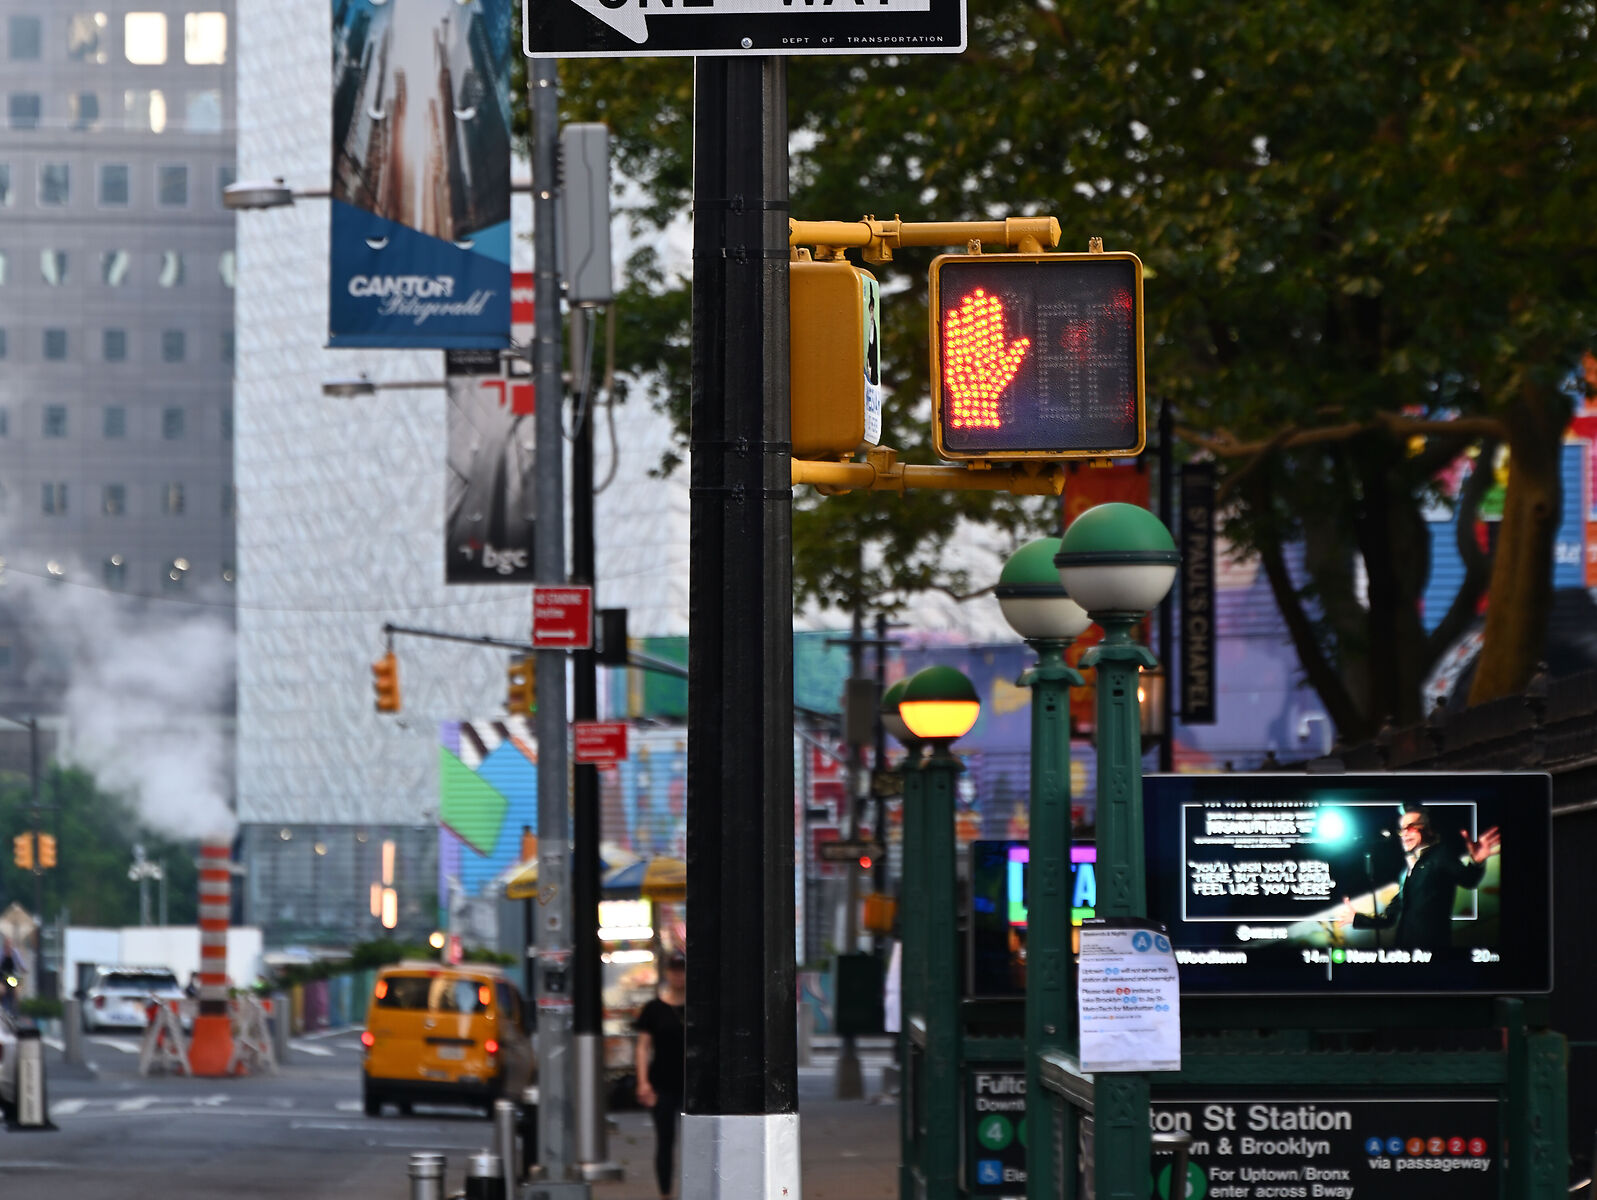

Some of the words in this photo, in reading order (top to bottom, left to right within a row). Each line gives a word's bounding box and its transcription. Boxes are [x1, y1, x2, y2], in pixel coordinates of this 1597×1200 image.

[847, 36, 944, 44] TRANSPORTATION
[348, 275, 455, 297] CANTOR
[378, 289, 497, 327] Fitzgerald
[1188, 534, 1208, 612] PAUL'S
[1188, 616, 1208, 714] CHAPEL
[1298, 861, 1330, 872] BEEN
[1234, 873, 1260, 883] BUT
[1192, 883, 1227, 895] FEEL
[1229, 883, 1259, 895] LIKE
[1260, 883, 1290, 895] YOU
[1137, 936, 1147, 947] A
[1175, 949, 1247, 964] Woodlawn
[1346, 950, 1377, 965] New
[1378, 950, 1411, 965] Lots
[1412, 950, 1432, 964] Av
[1203, 1105, 1237, 1131] St
[1248, 1105, 1352, 1131] Station
[986, 1122, 1003, 1142] 4
[1217, 1137, 1233, 1156] &
[1240, 1137, 1331, 1158] Brooklyn
[1369, 1141, 1380, 1152] A
[1389, 1141, 1401, 1152] C
[1368, 1156, 1391, 1169] via
[1395, 1158, 1491, 1172] passageway
[1209, 1167, 1236, 1181] For
[1209, 1186, 1250, 1198] enter
[1255, 1186, 1307, 1198] across
[1312, 1185, 1354, 1200] Bway
